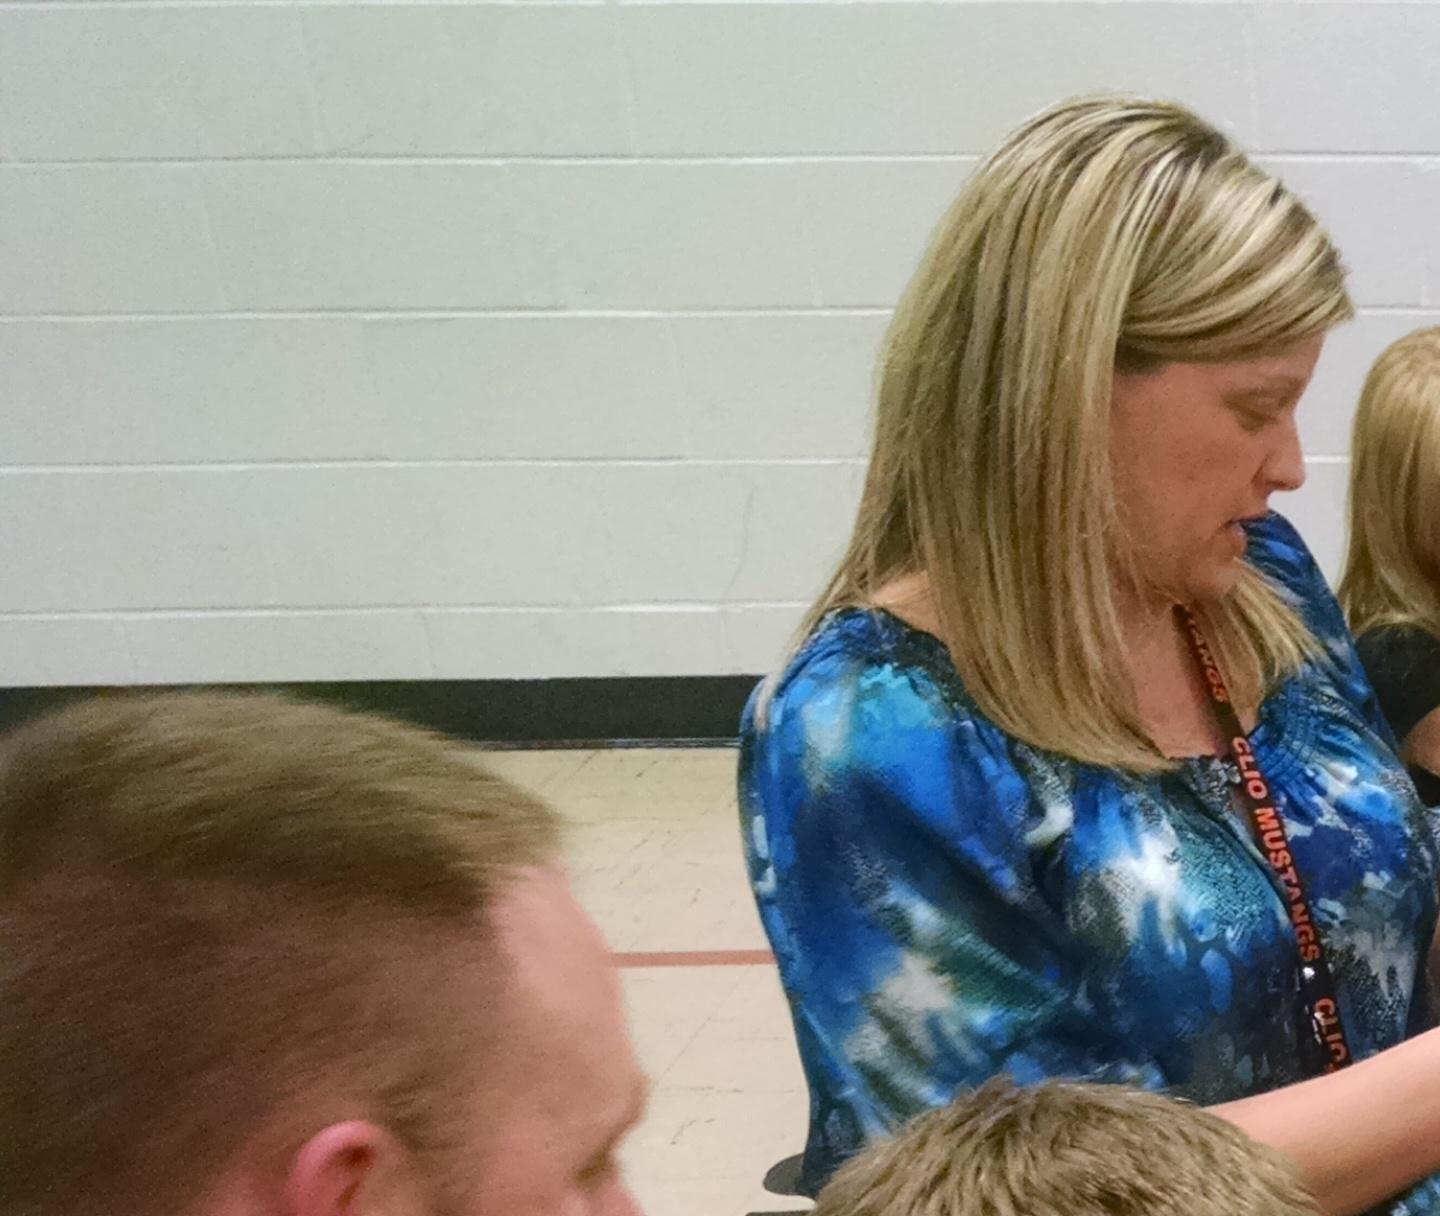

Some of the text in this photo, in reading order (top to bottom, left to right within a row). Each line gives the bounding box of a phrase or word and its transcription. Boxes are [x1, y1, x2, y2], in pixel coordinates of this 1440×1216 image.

[1232, 736, 1322, 962] CLIO MUSTANGS
[1314, 997, 1347, 1061] CLIO
